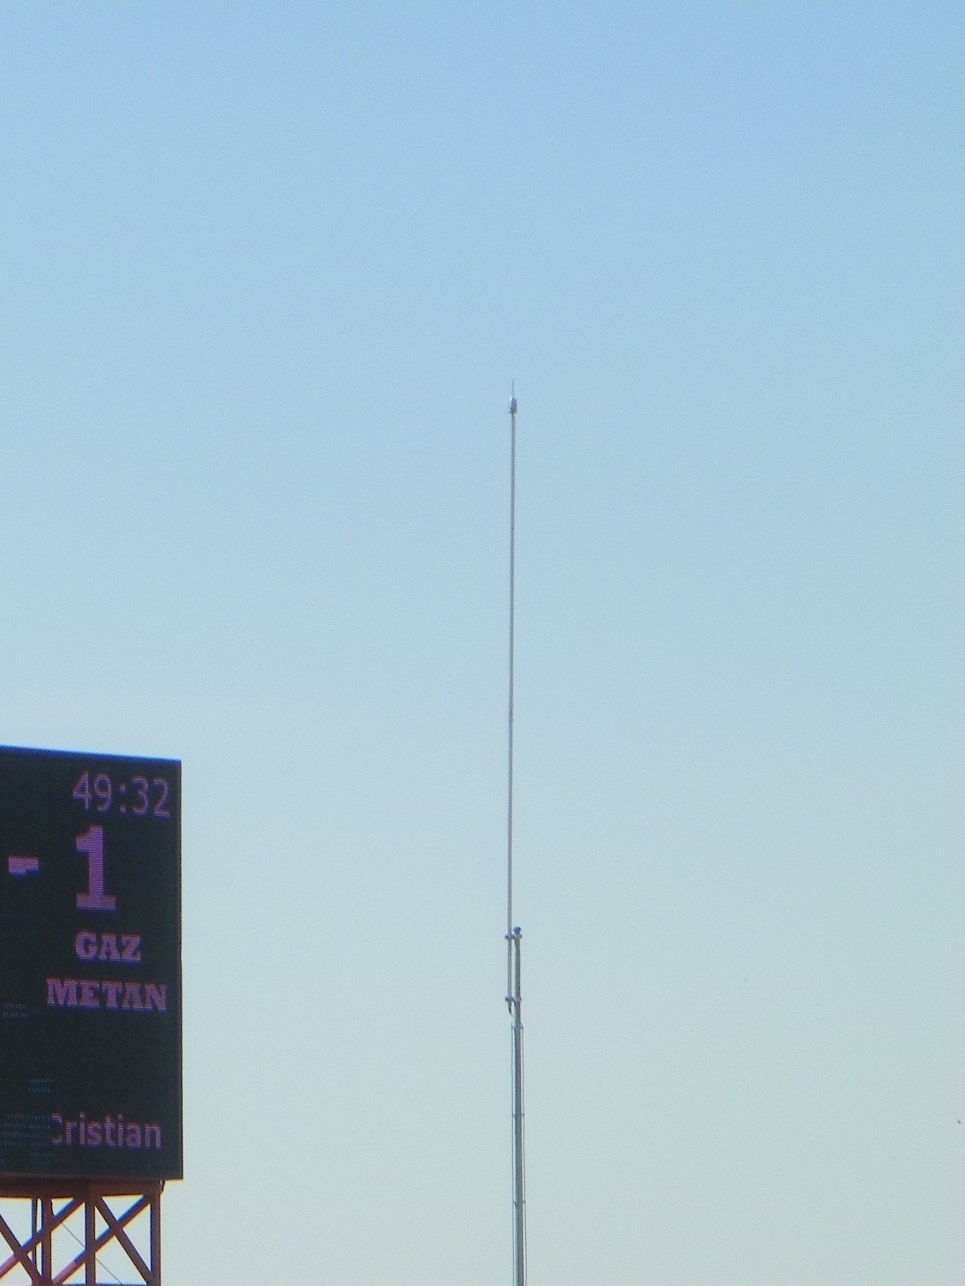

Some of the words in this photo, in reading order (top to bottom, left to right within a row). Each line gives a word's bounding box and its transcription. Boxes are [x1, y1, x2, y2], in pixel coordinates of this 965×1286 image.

[73, 772, 171, 818] 49:32
[76, 824, 117, 911] 1
[76, 931, 142, 963] GAZ
[46, 978, 168, 1012] METAN
